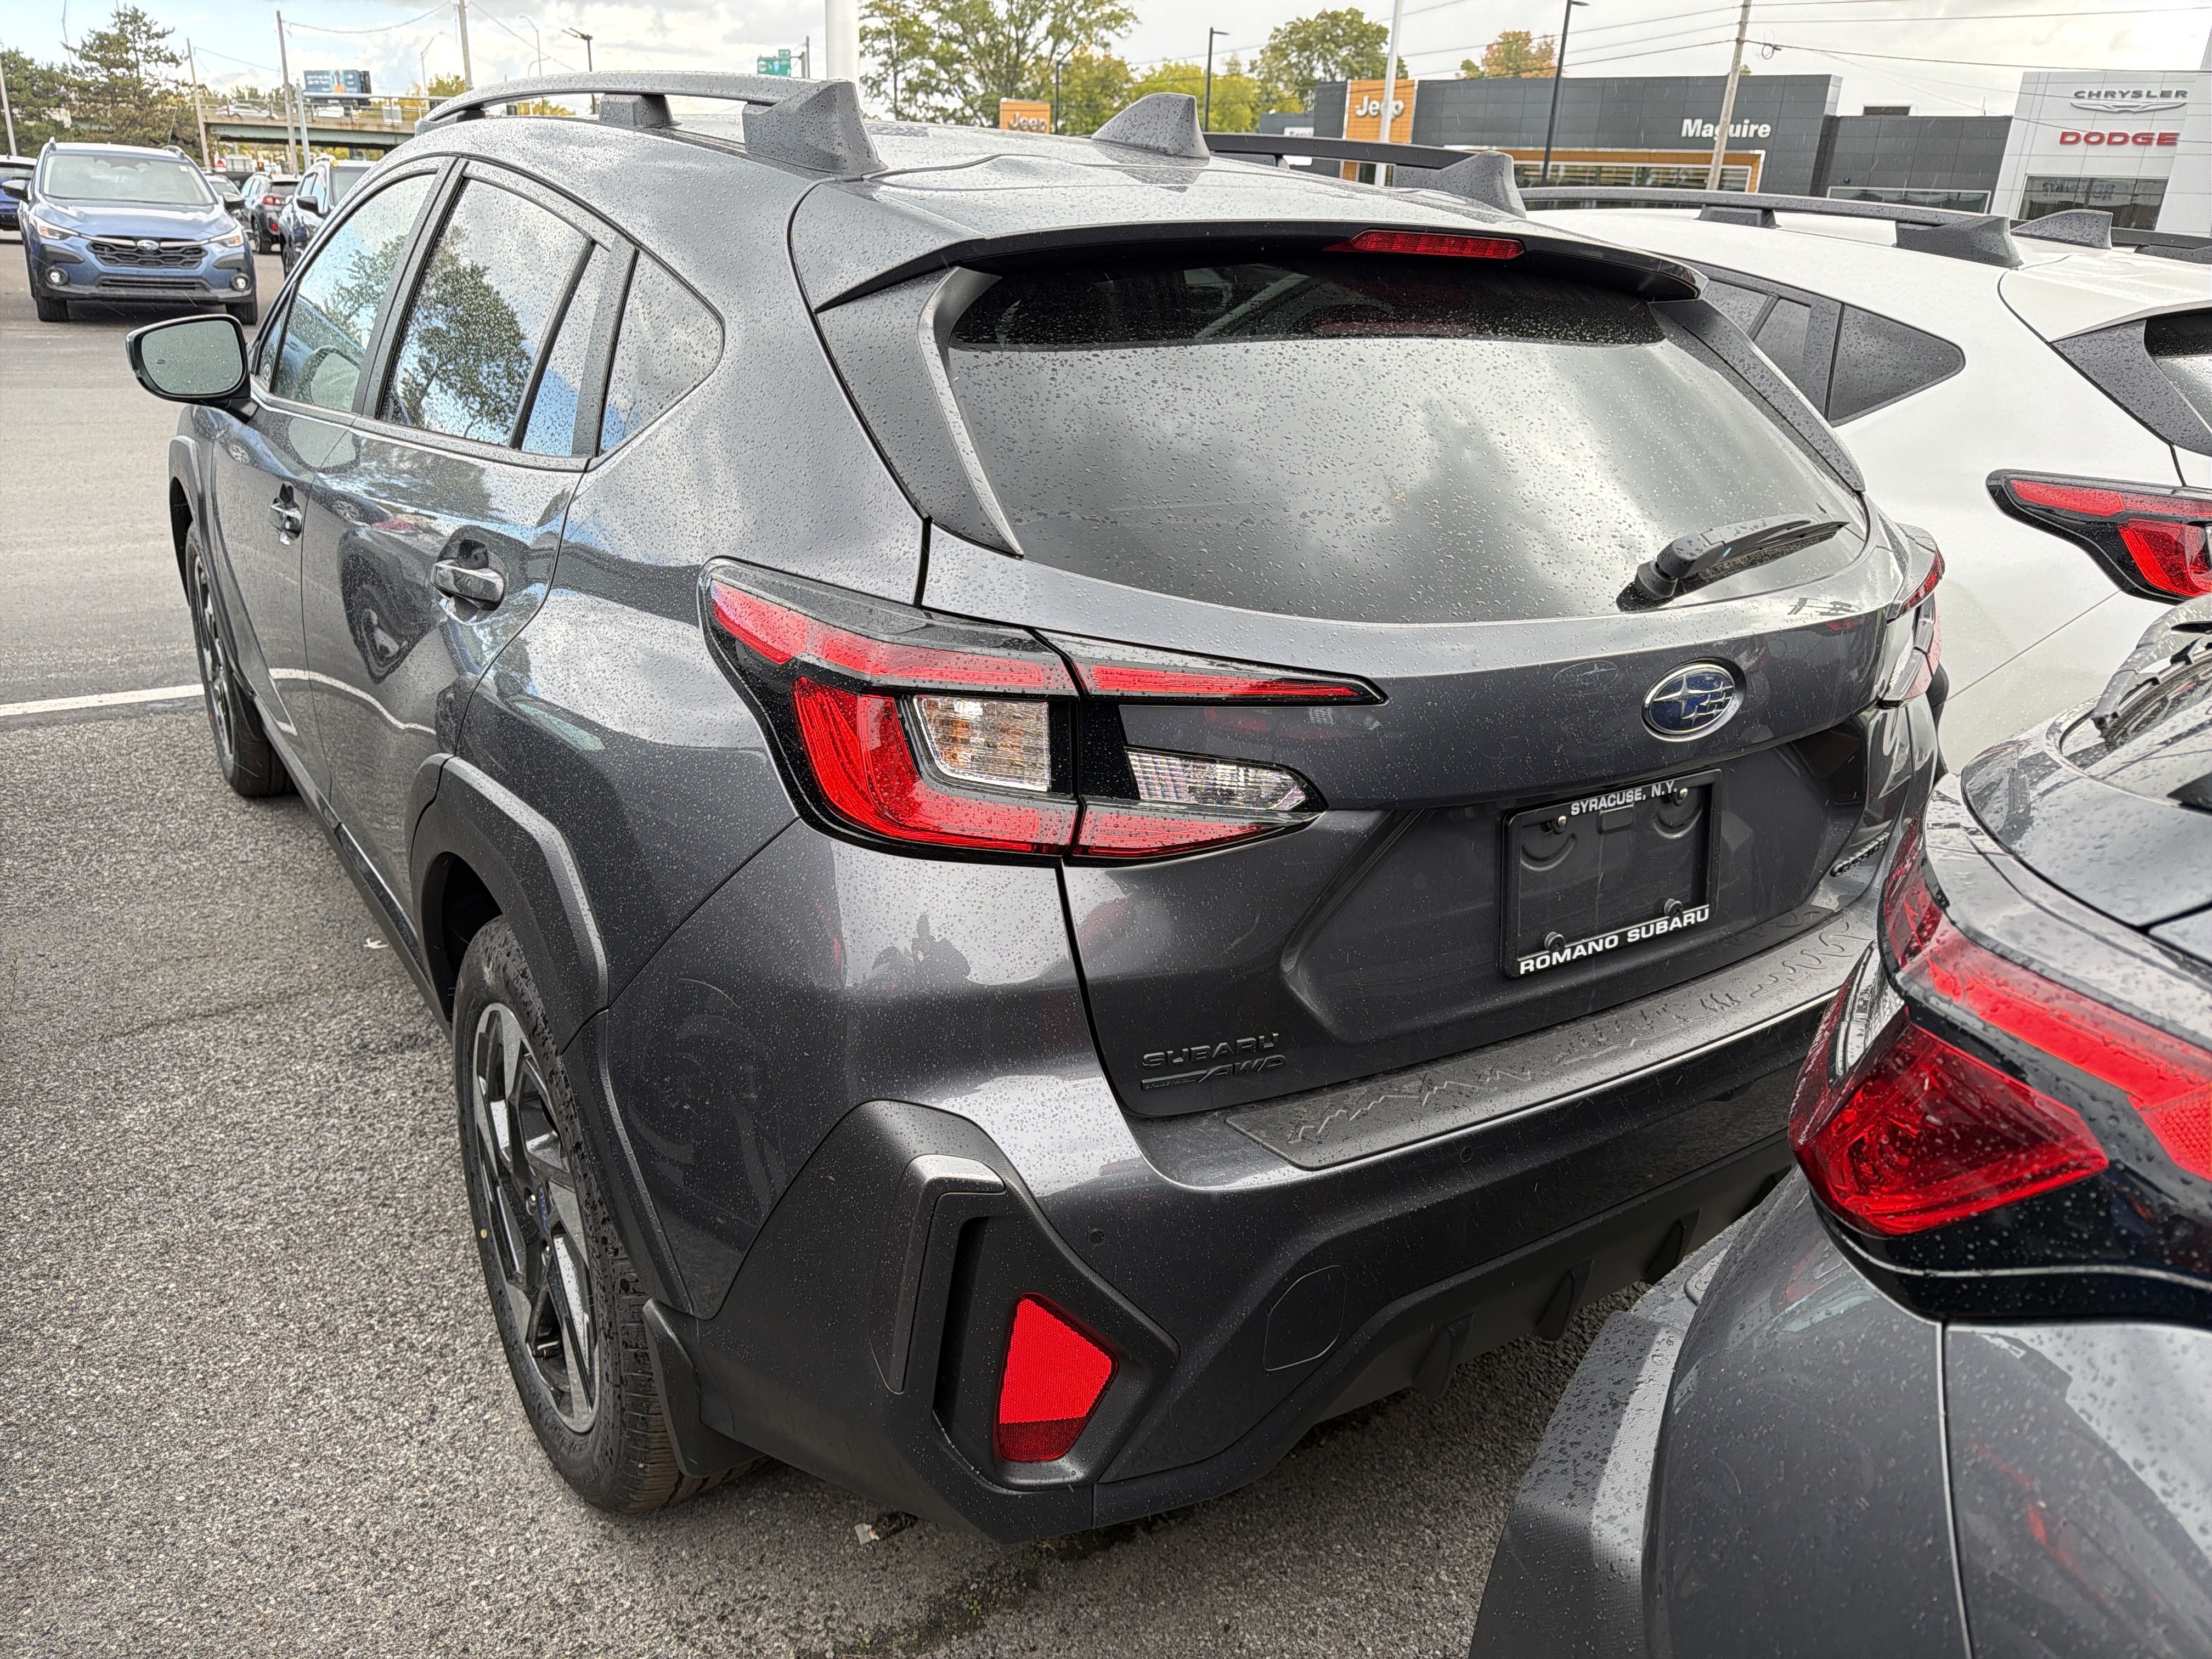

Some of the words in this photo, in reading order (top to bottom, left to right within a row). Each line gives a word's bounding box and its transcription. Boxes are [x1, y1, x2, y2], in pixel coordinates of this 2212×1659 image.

[1355, 95, 1404, 120] Jep
[2073, 90, 2188, 99] CHRYSLER
[1008, 111, 1047, 132] Jeep
[2059, 131, 2181, 146] DODGE
[1571, 788, 1646, 816] SYRACUSE,
[1651, 780, 1677, 798] N.Y.
[1520, 935, 1618, 975] ROMANO
[1627, 908, 1709, 943] SUBARU
[1142, 1033, 1279, 1067] SUBARU
[1198, 1054, 1288, 1084] AWD
